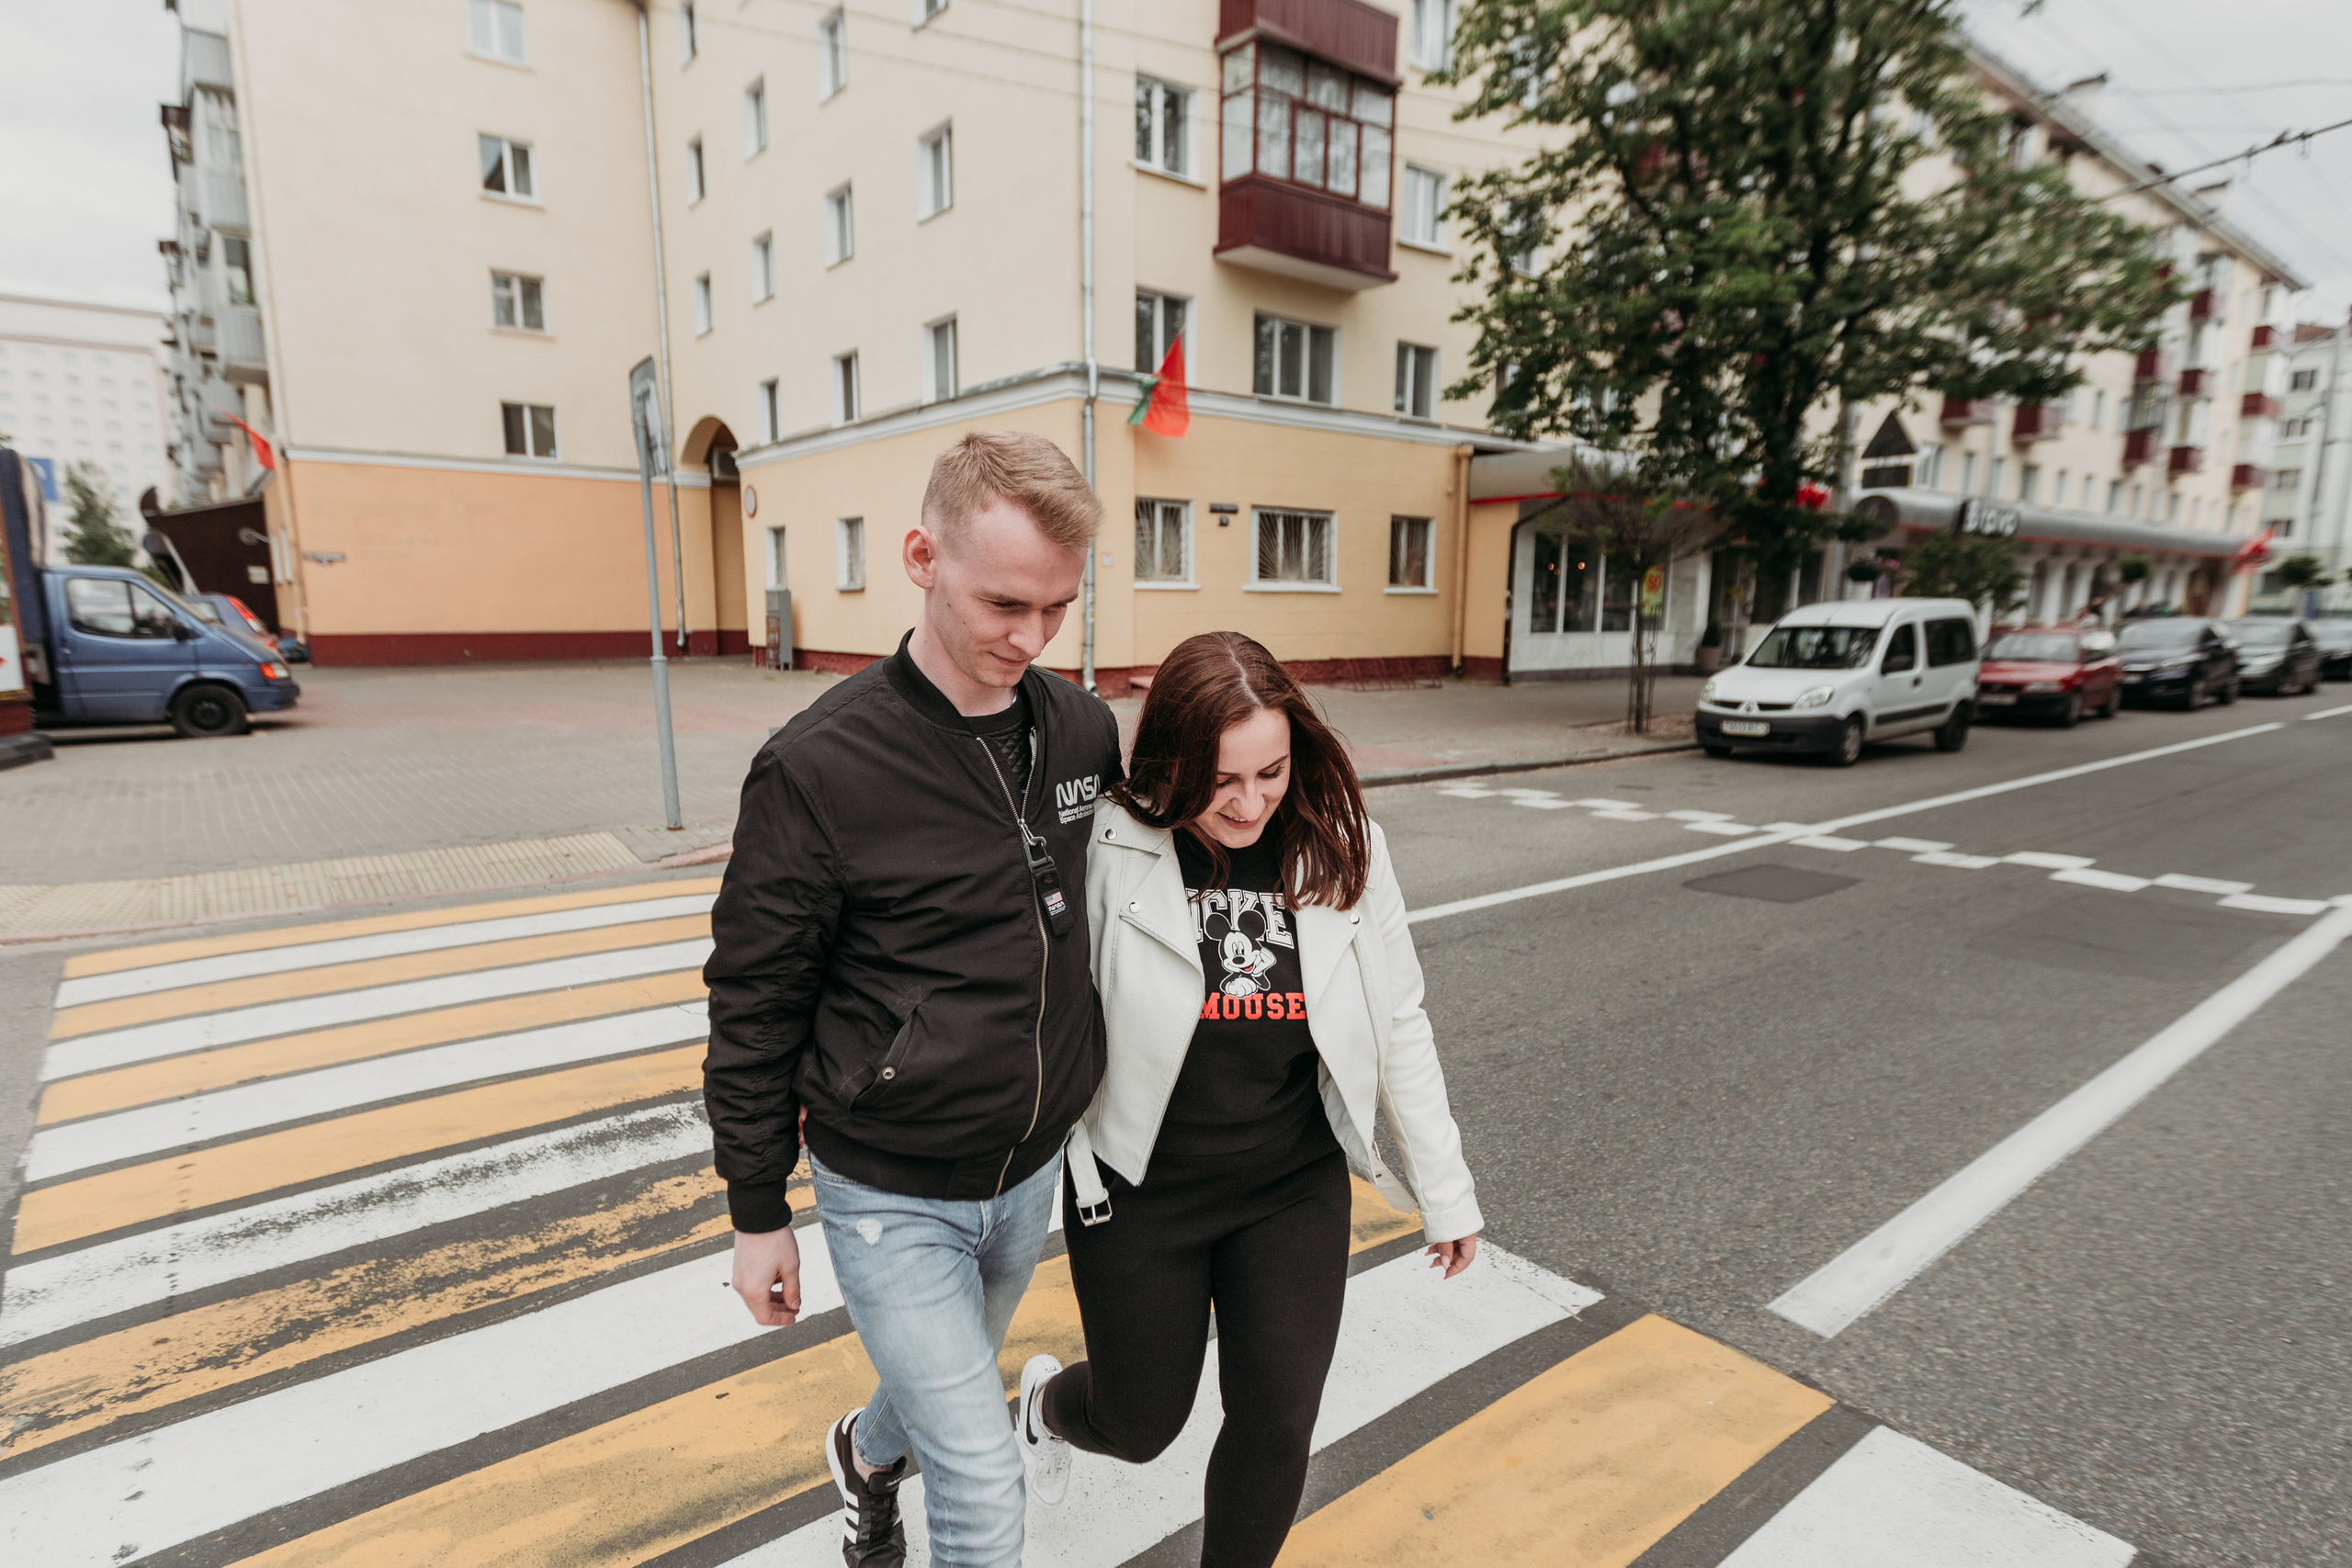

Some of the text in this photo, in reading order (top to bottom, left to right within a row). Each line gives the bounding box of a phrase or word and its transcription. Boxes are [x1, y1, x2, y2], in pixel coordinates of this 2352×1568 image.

[1056, 774, 1100, 807] NASA
[1058, 806, 1079, 818] National
[1200, 991, 1306, 1020] MOUSE
